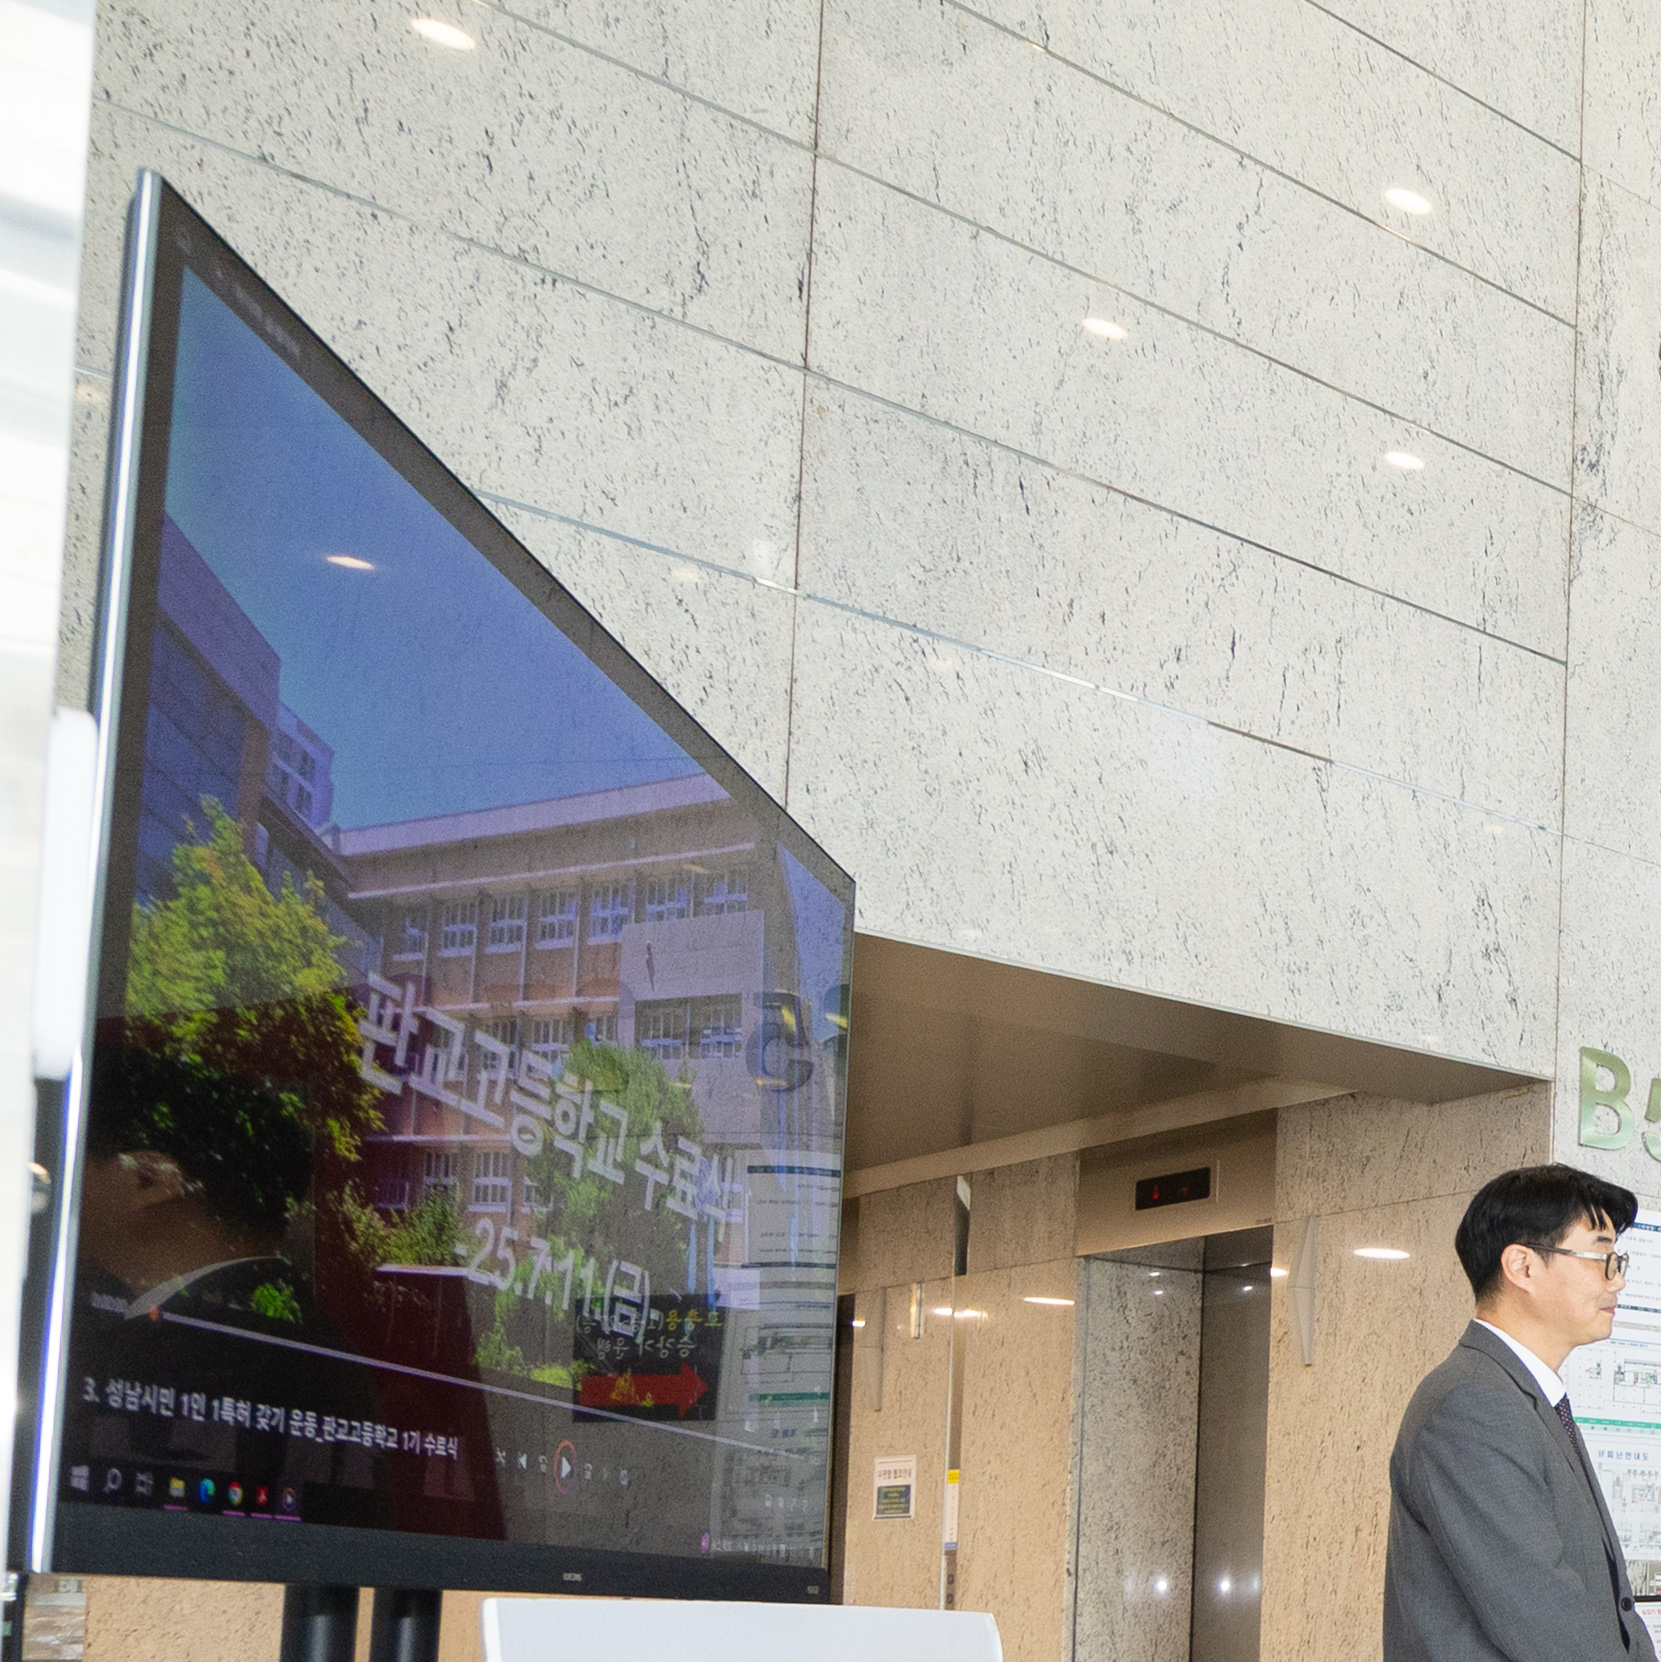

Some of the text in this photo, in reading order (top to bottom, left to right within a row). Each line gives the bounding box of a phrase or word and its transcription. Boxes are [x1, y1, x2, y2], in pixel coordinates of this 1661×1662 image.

[358, 972, 628, 1185] 판교고등학교
[634, 1122, 737, 1244] 수료식
[82, 1376, 100, 1403] 3.
[106, 1377, 176, 1418] 성남시민
[181, 1392, 206, 1422] 1인
[212, 1397, 252, 1428] 1특허
[256, 1404, 285, 1434] 갖기
[403, 1430, 421, 1455] 1기
[424, 1434, 459, 1460] 수료식
